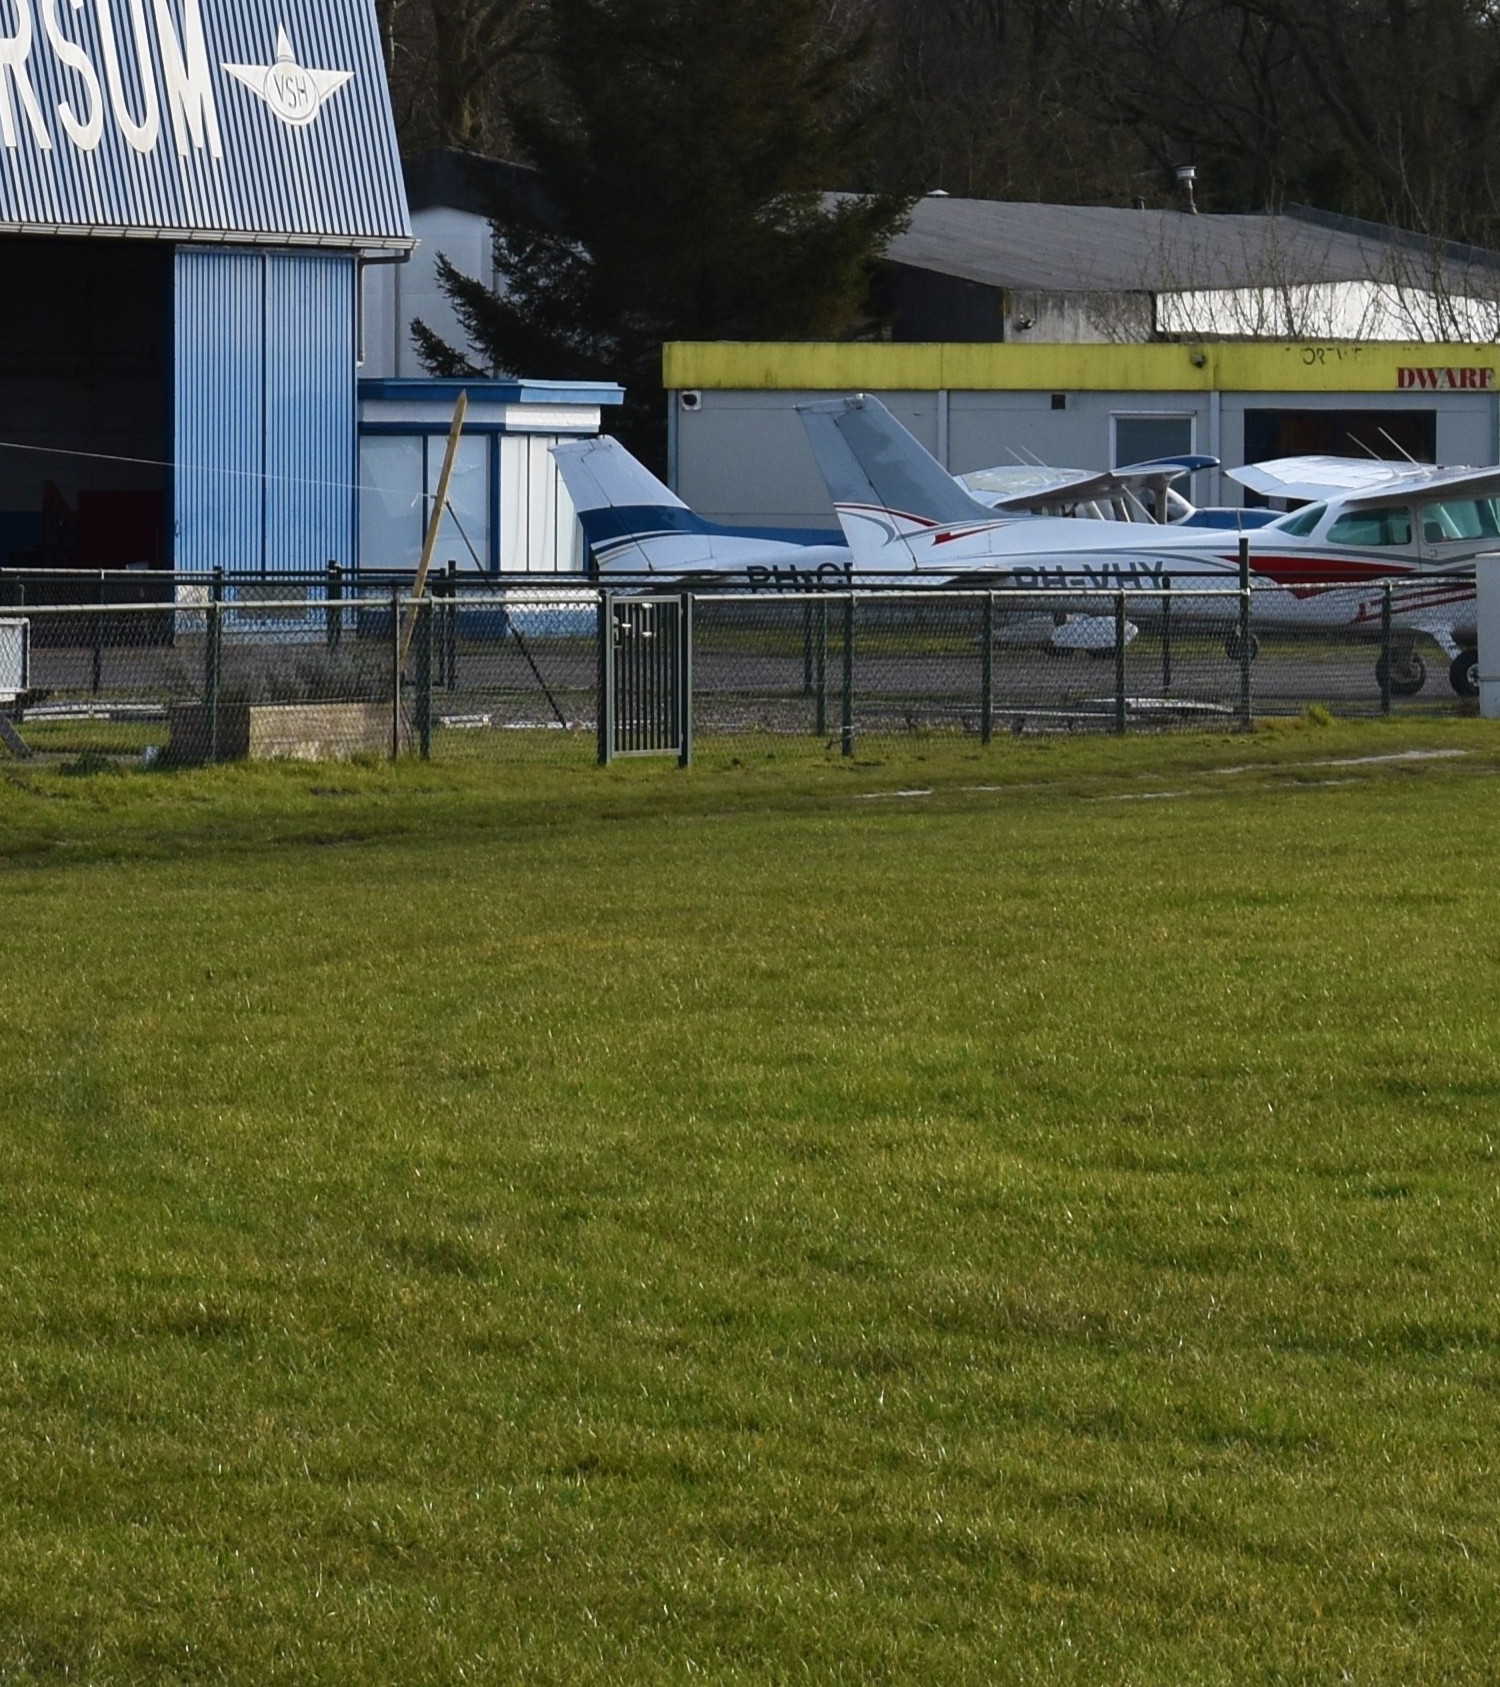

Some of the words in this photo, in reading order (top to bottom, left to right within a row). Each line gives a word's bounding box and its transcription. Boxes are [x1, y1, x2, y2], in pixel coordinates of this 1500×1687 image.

[272, 73, 309, 110] VSH
[1397, 367, 1494, 389] DWARF
[1012, 560, 1164, 590] PH-VHY
